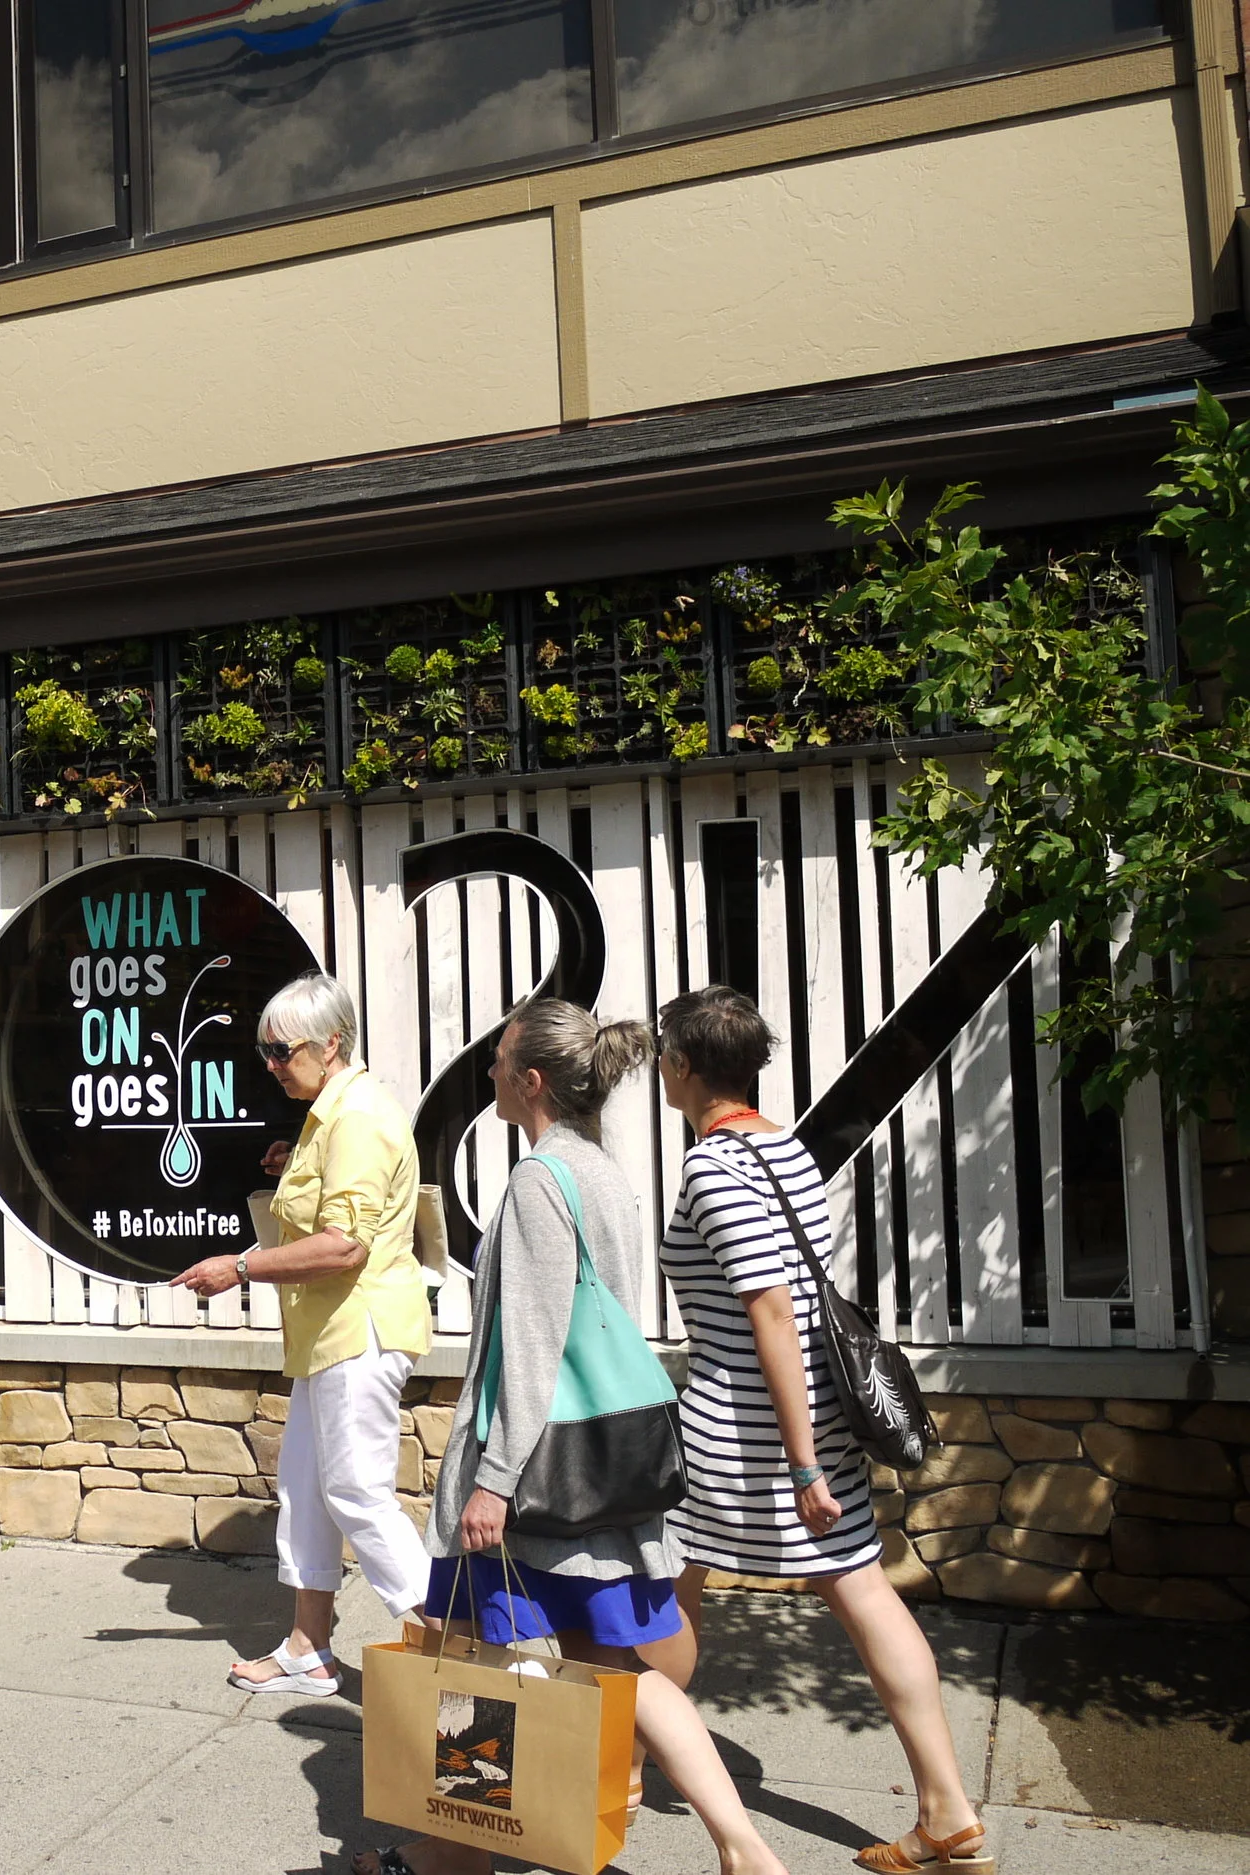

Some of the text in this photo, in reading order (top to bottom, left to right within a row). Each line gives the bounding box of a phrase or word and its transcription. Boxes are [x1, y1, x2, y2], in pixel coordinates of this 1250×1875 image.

[81, 888, 206, 949] WHAT
[69, 954, 166, 1008] goes
[81, 1006, 154, 1068] ON,
[71, 1060, 248, 1127] goes IN.
[119, 1207, 241, 1238] BeToxinFree
[426, 1797, 524, 1836] STONEWATERS
